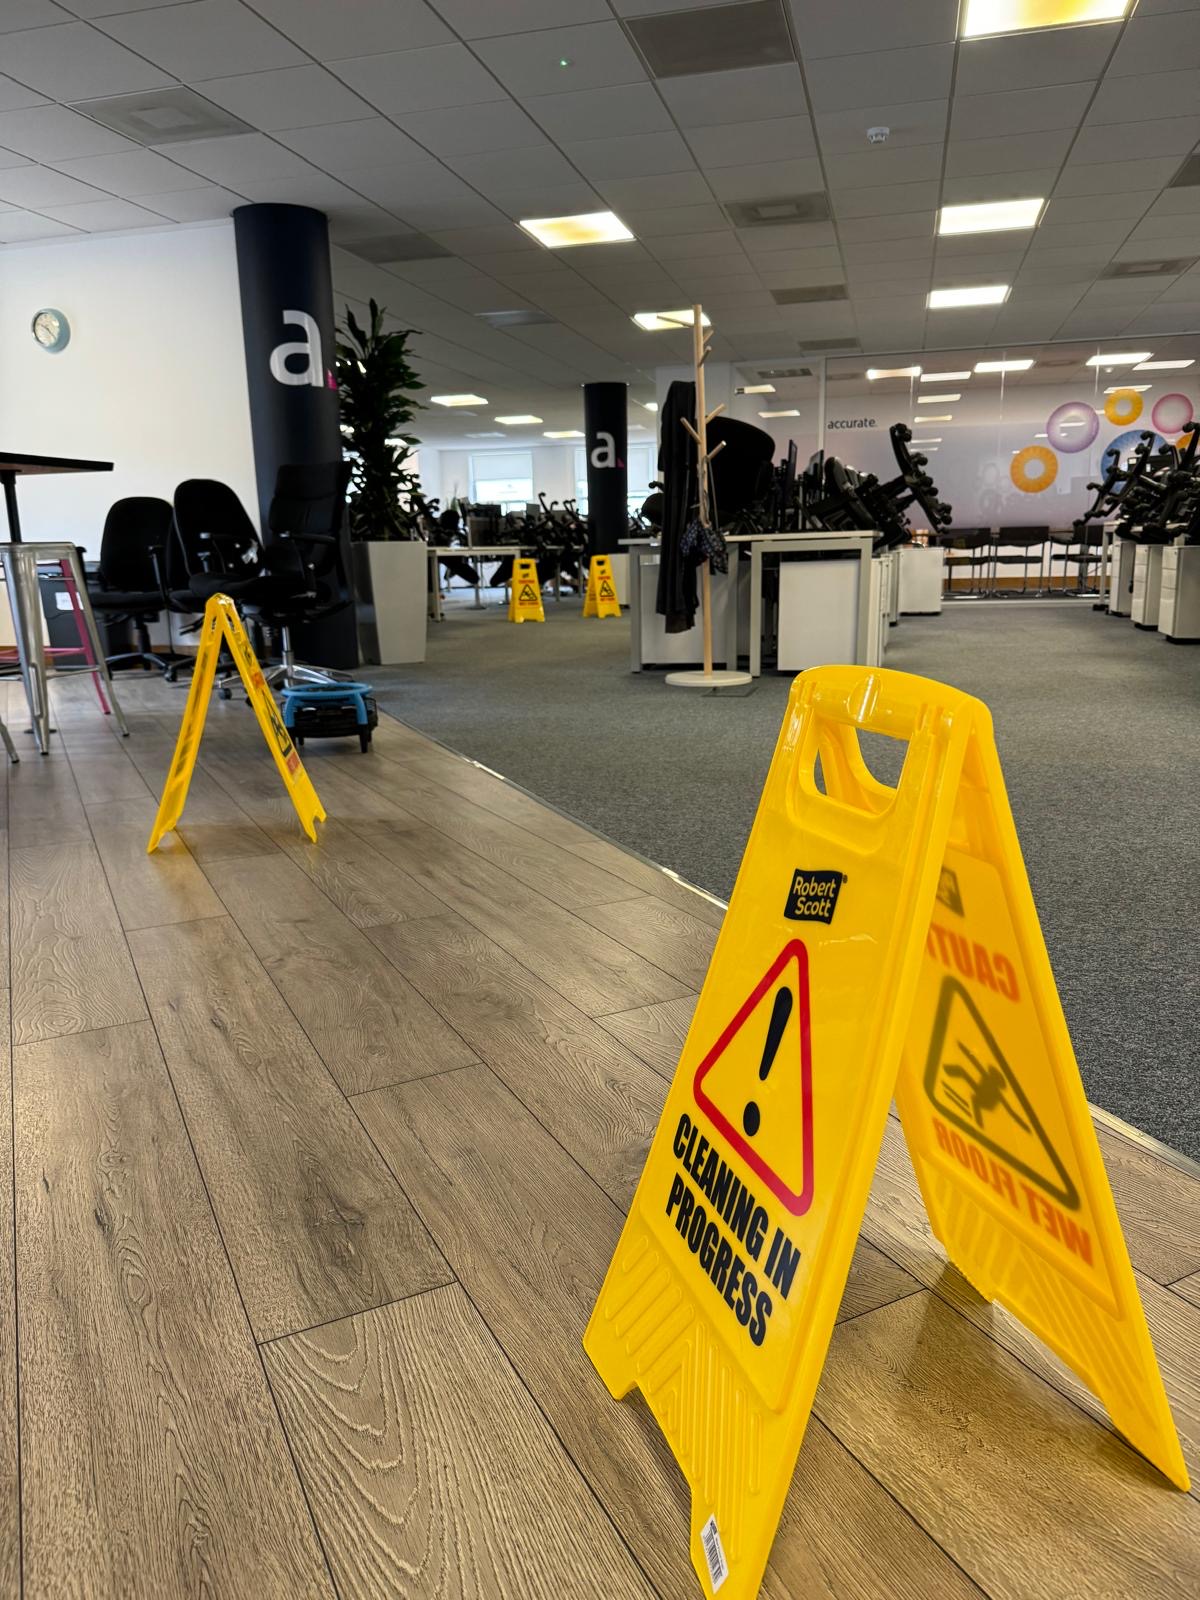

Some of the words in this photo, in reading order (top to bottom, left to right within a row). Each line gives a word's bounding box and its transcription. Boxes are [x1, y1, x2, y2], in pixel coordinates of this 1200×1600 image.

[793, 876, 836, 898] Robert
[794, 896, 831, 918] Scott
[673, 1113, 769, 1262] CLEANING
[764, 1227, 802, 1300] IN
[665, 1172, 773, 1347] PROGRESS
